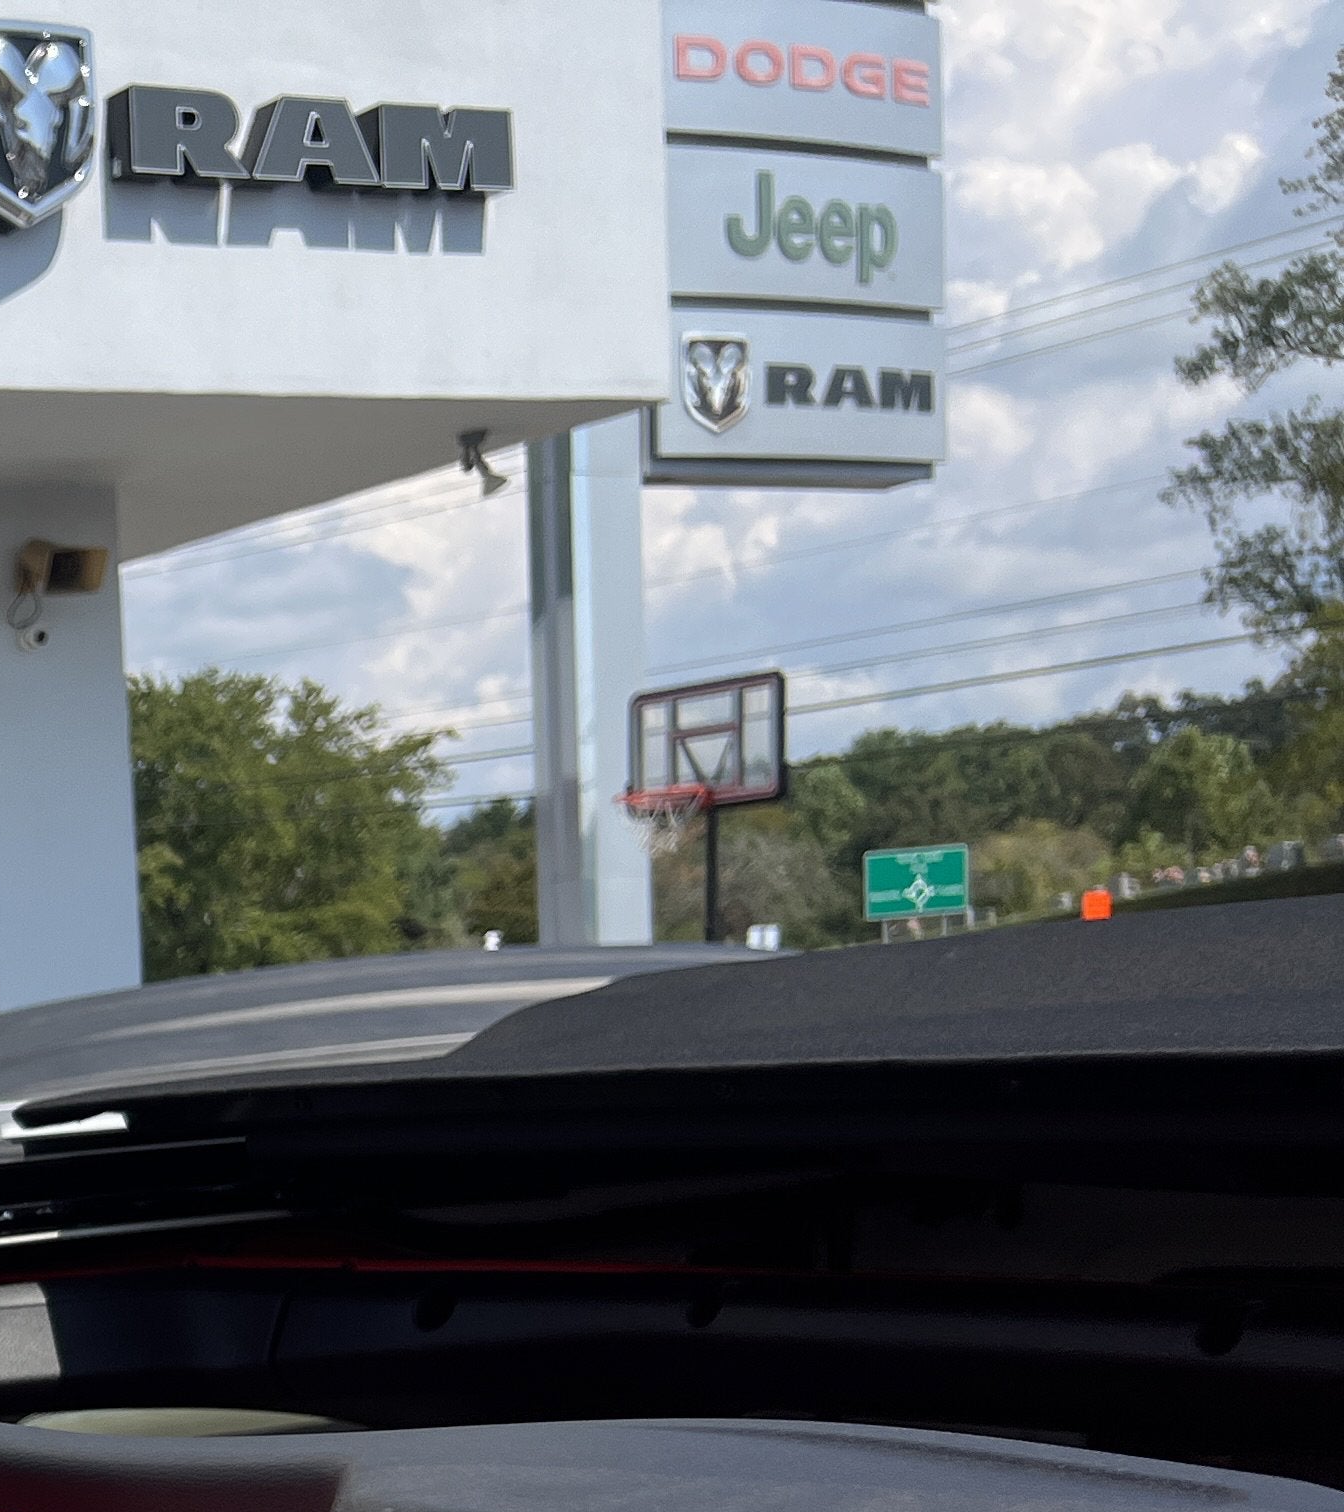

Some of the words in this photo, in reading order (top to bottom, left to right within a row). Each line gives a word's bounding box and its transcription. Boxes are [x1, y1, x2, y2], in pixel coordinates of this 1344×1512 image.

[673, 33, 930, 108] DODGE
[108, 83, 516, 196] RAM
[724, 168, 899, 286] Jeep
[763, 361, 937, 413] RAM
